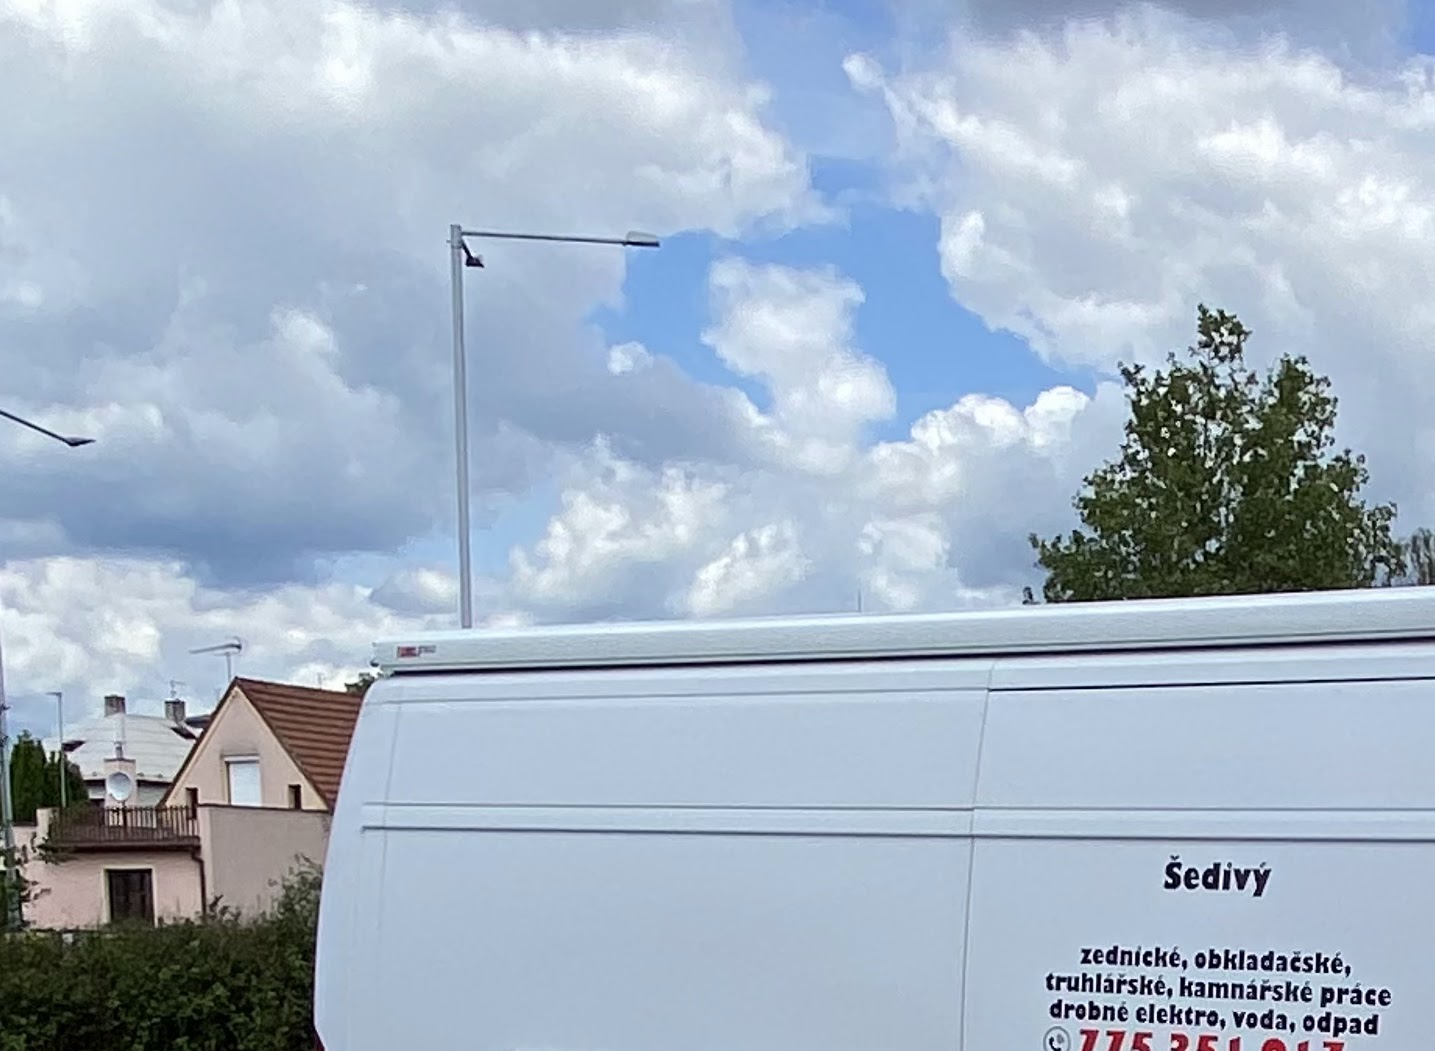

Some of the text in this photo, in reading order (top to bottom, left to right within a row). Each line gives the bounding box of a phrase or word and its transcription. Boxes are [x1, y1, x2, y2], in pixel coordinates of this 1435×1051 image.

[1163, 855, 1272, 898] Šedivý
[1080, 945, 1352, 977] zednické, obkladačské,
[1045, 972, 1392, 1008] truhlářské, kamnářské práce
[1049, 998, 1379, 1038] drobné elektro, voda, odpad
